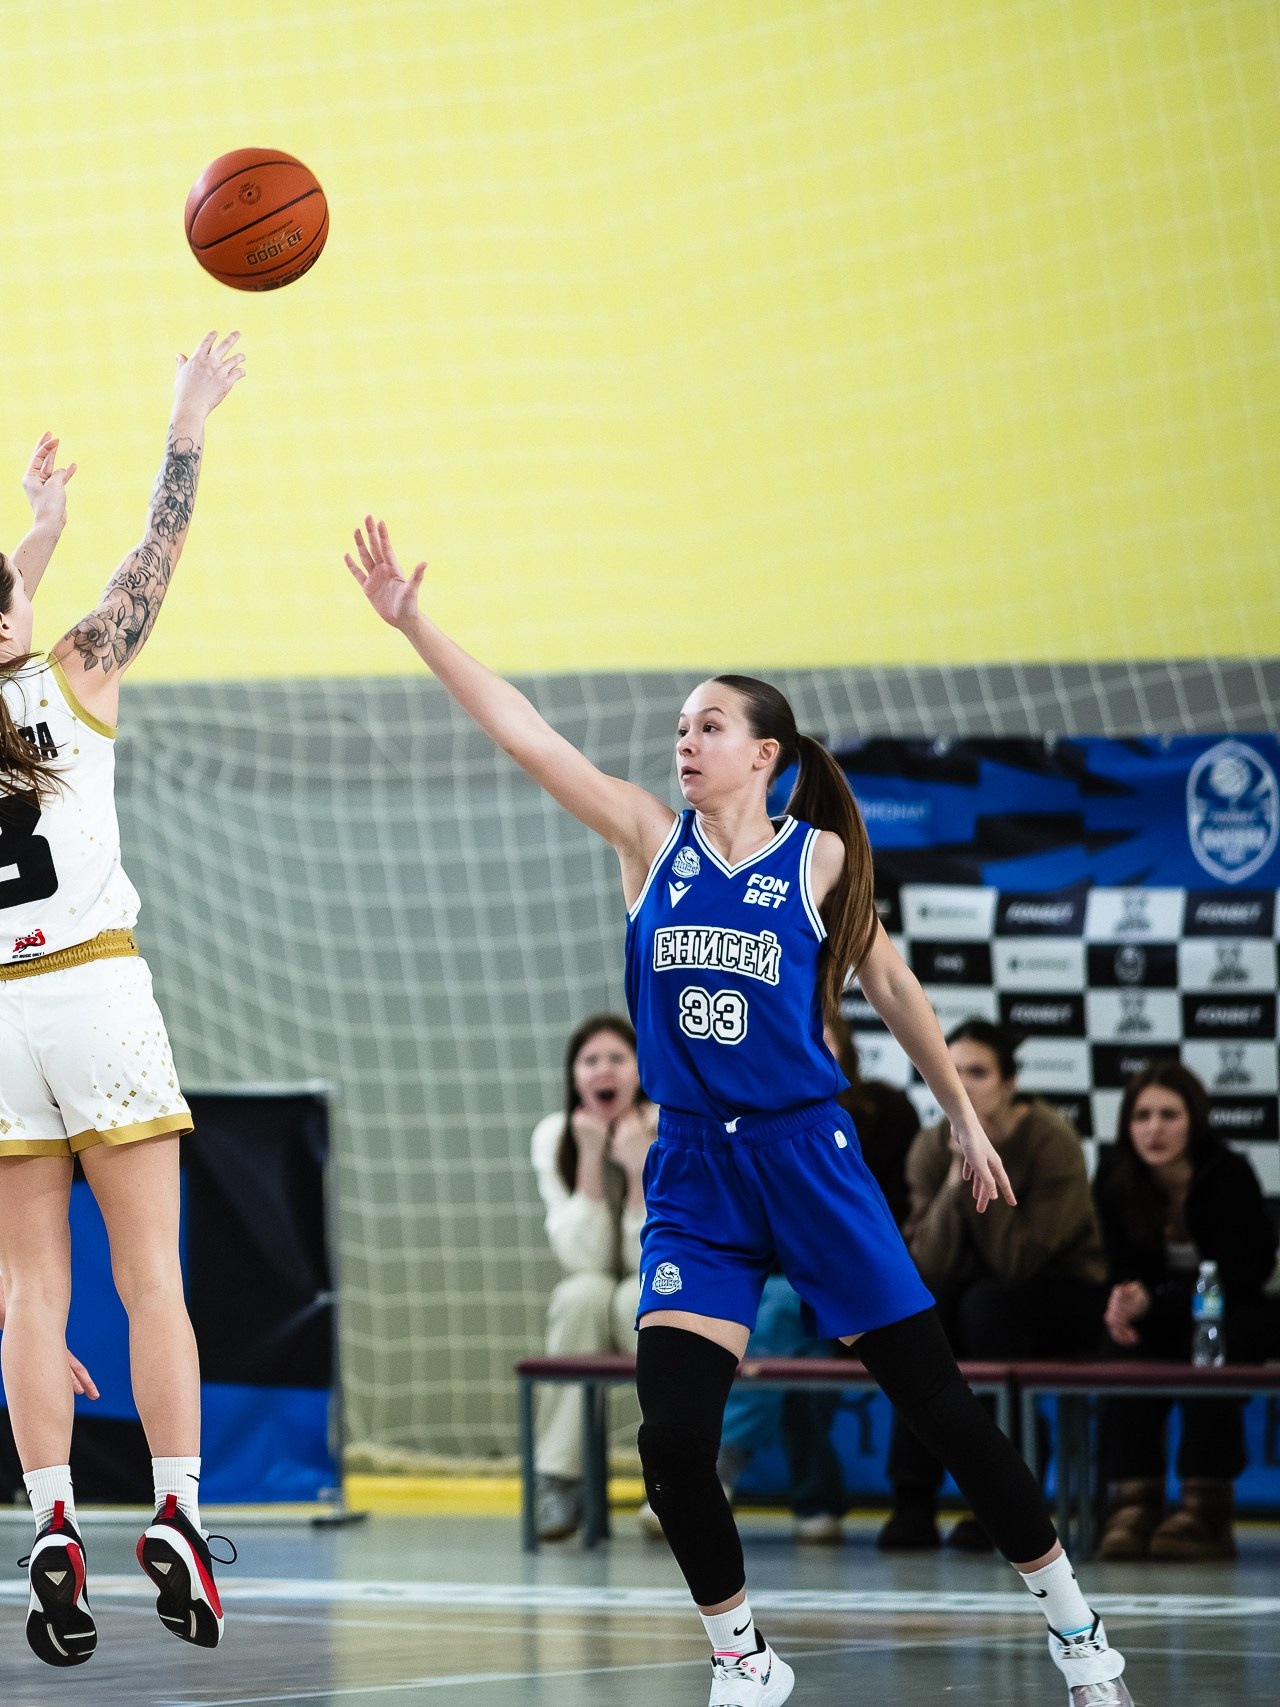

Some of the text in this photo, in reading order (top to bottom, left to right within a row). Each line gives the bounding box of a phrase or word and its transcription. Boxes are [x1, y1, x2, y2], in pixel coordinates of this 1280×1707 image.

[743, 890, 786, 909] BET
[746, 874, 790, 893] FON
[653, 926, 782, 986] ЕНИСЕЙ
[679, 986, 748, 1045] 33
